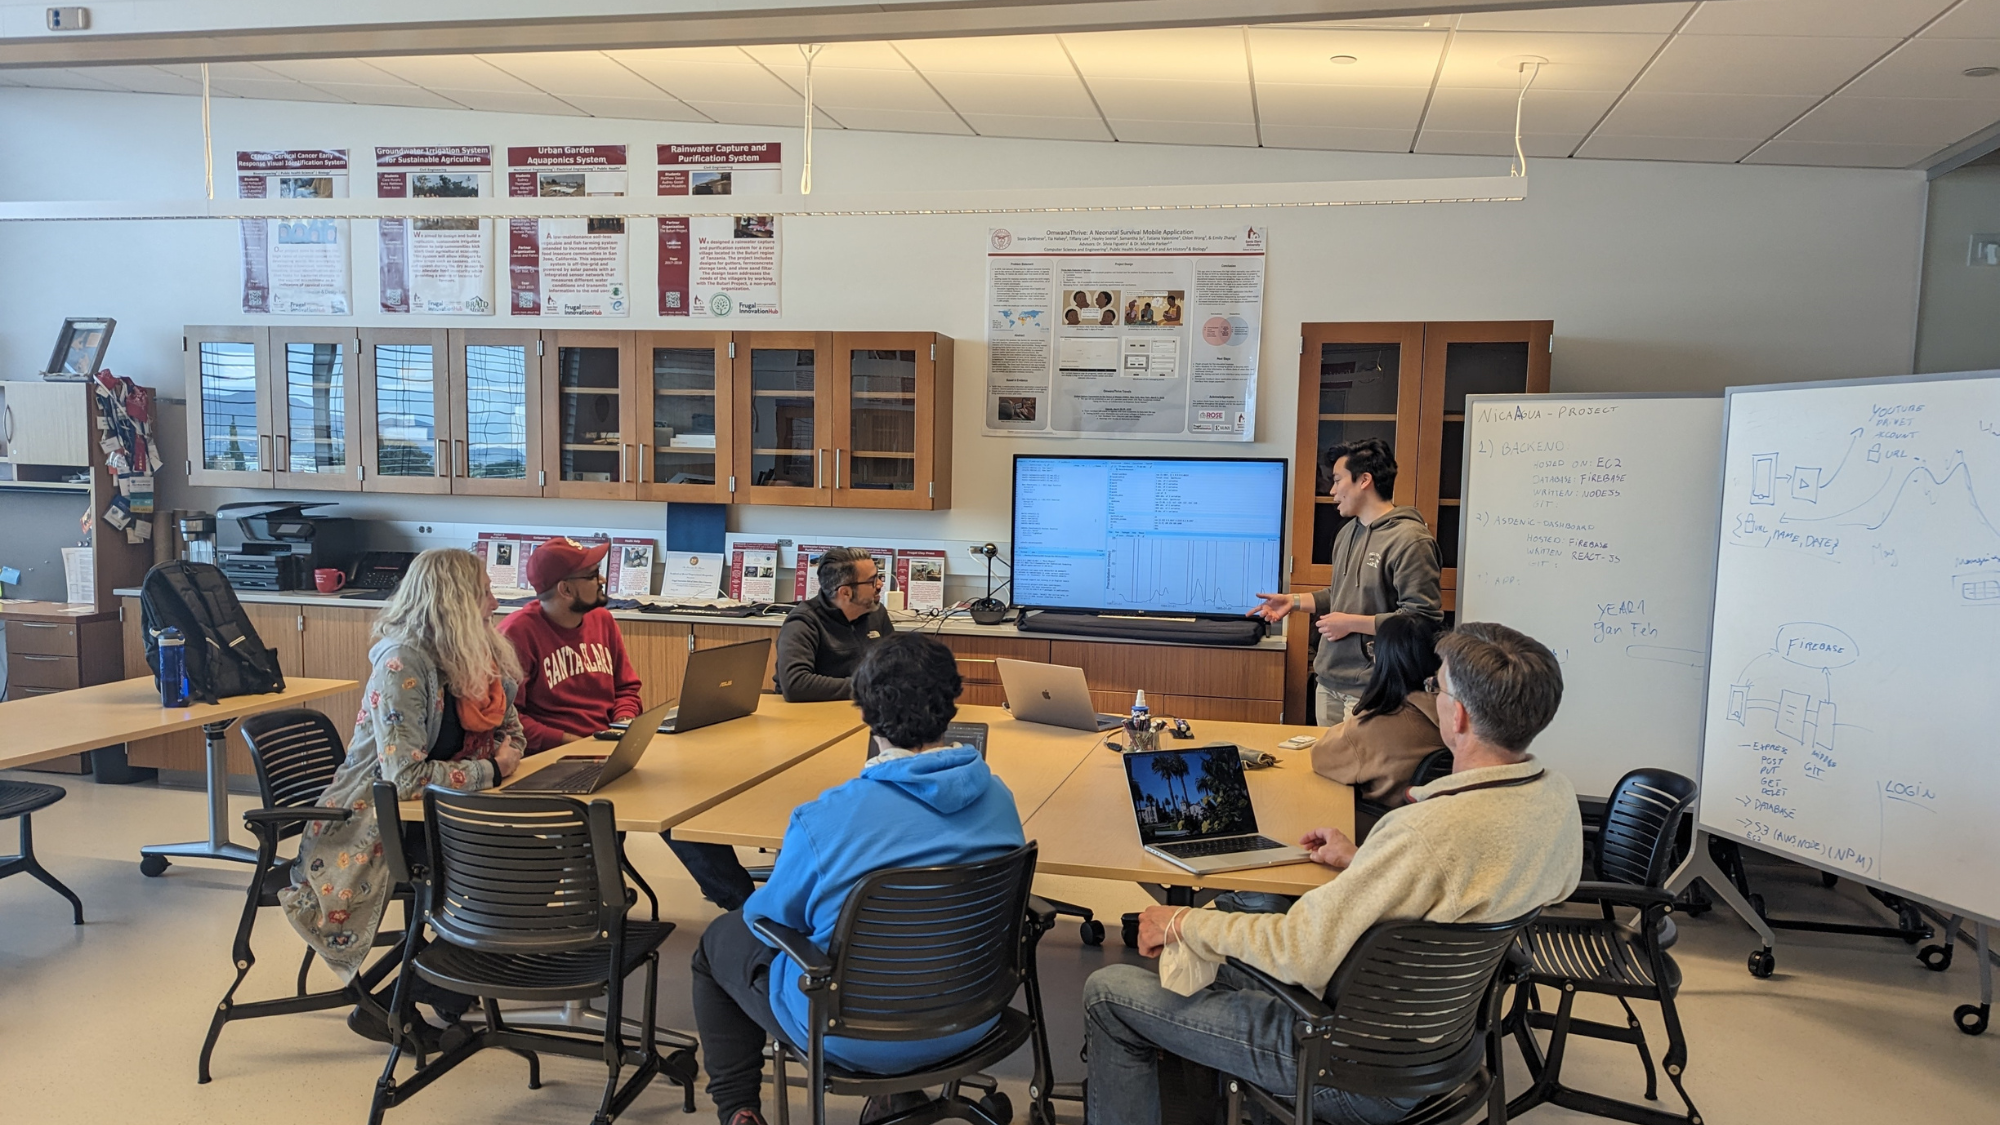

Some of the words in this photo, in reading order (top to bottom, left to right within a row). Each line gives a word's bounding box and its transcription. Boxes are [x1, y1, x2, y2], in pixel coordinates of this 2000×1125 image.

[1558, 406, 1619, 419] PROJECT
[1886, 450, 1908, 459] URL
[1596, 458, 1621, 469] EC2
[544, 645, 584, 690] SANTA
[1761, 756, 1783, 766] POST
[1760, 766, 1779, 775] PUT
[1761, 777, 1782, 788] GET
[1755, 798, 1796, 819] DATABASE
[1755, 822, 1769, 836] S3
